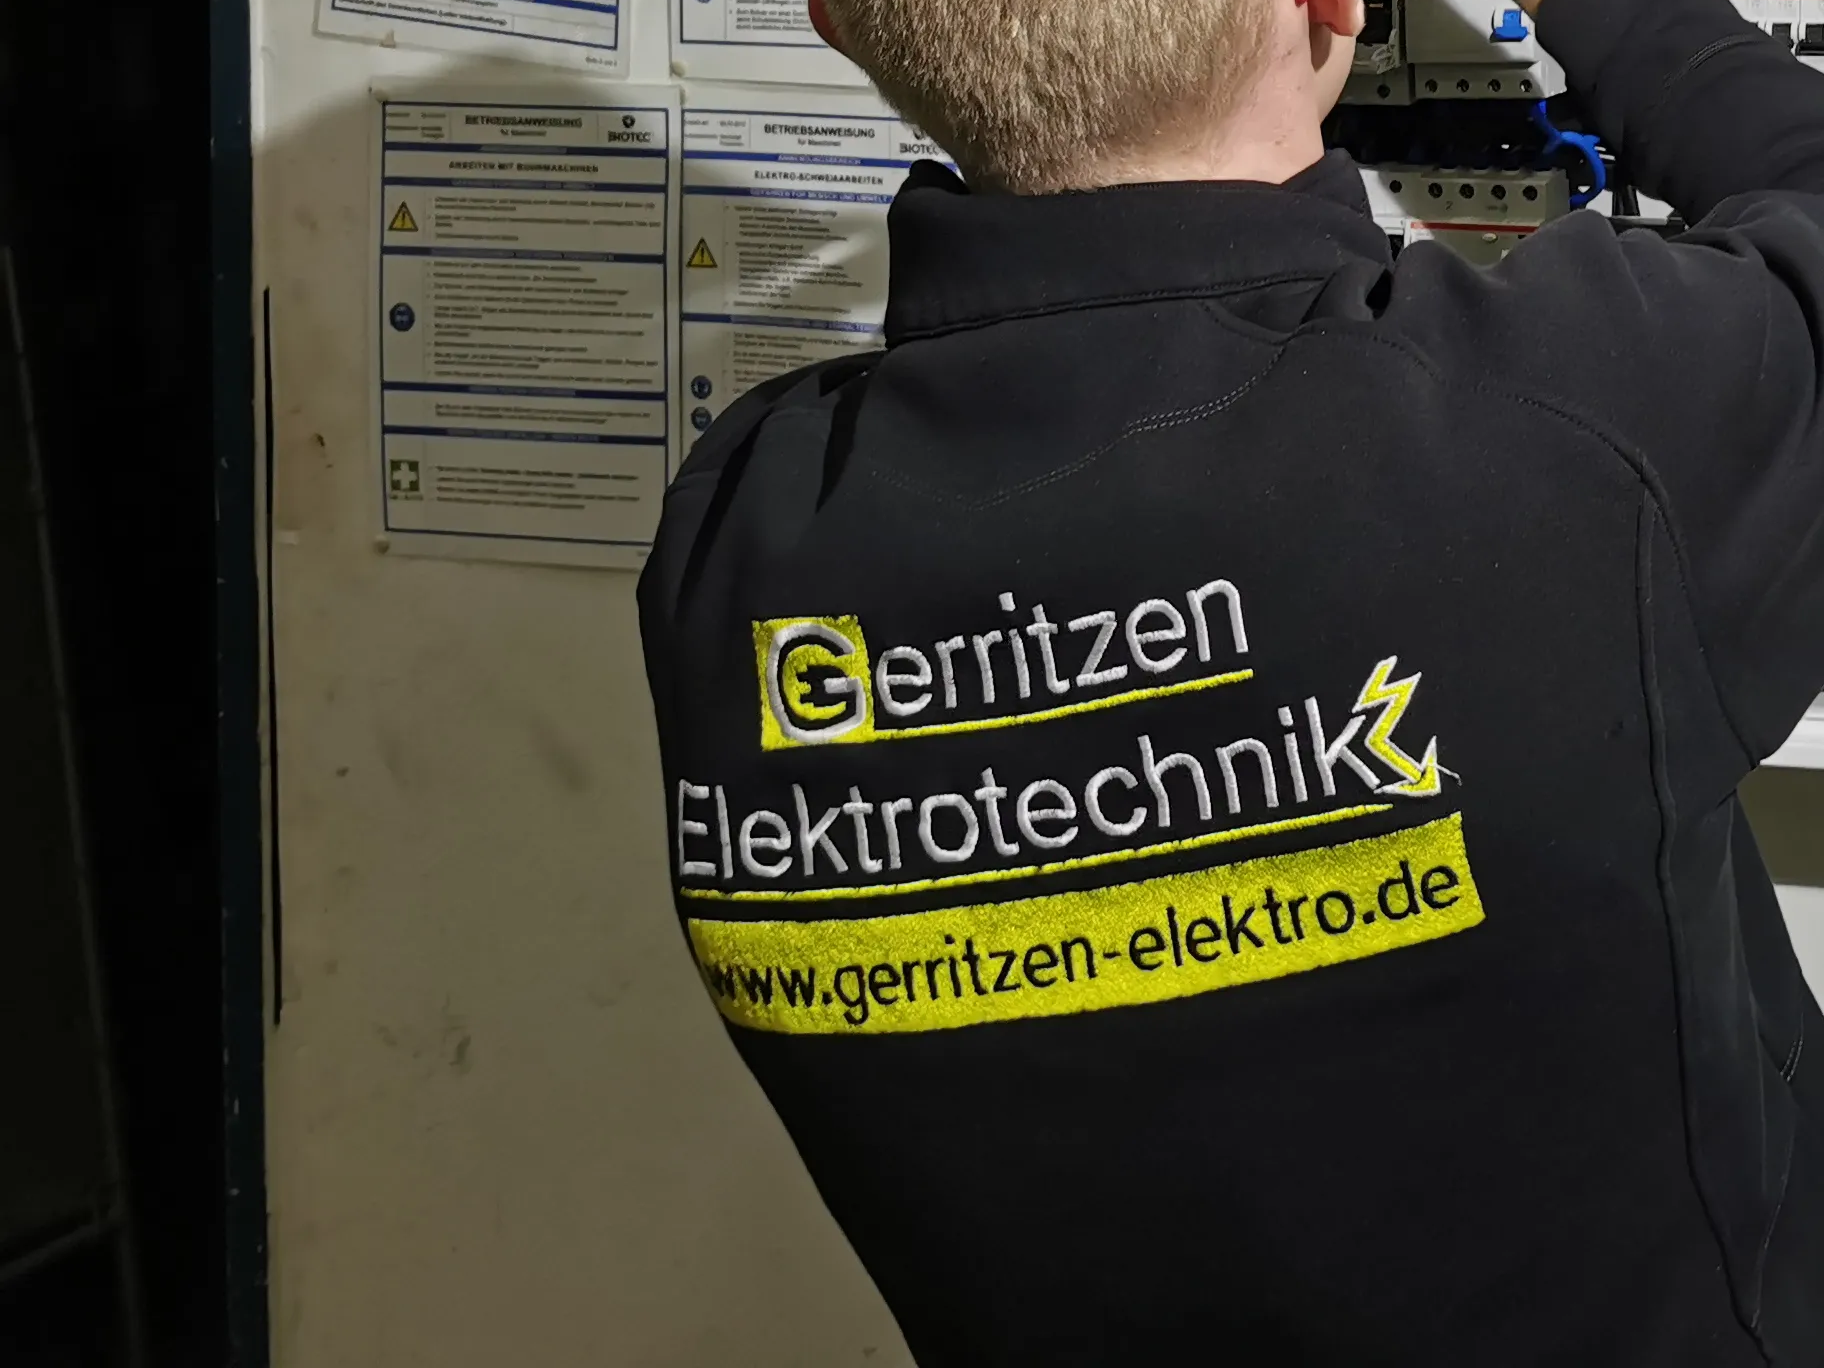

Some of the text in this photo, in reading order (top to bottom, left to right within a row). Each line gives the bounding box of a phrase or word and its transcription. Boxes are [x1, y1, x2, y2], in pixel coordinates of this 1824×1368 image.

[763, 123, 876, 139] BETRIEBSANWEISUNG
[766, 577, 1250, 745] Gerritzen
[675, 697, 1390, 882] Elektrotechnik
[704, 859, 1462, 1025] www.gerritzen-elektro.de
